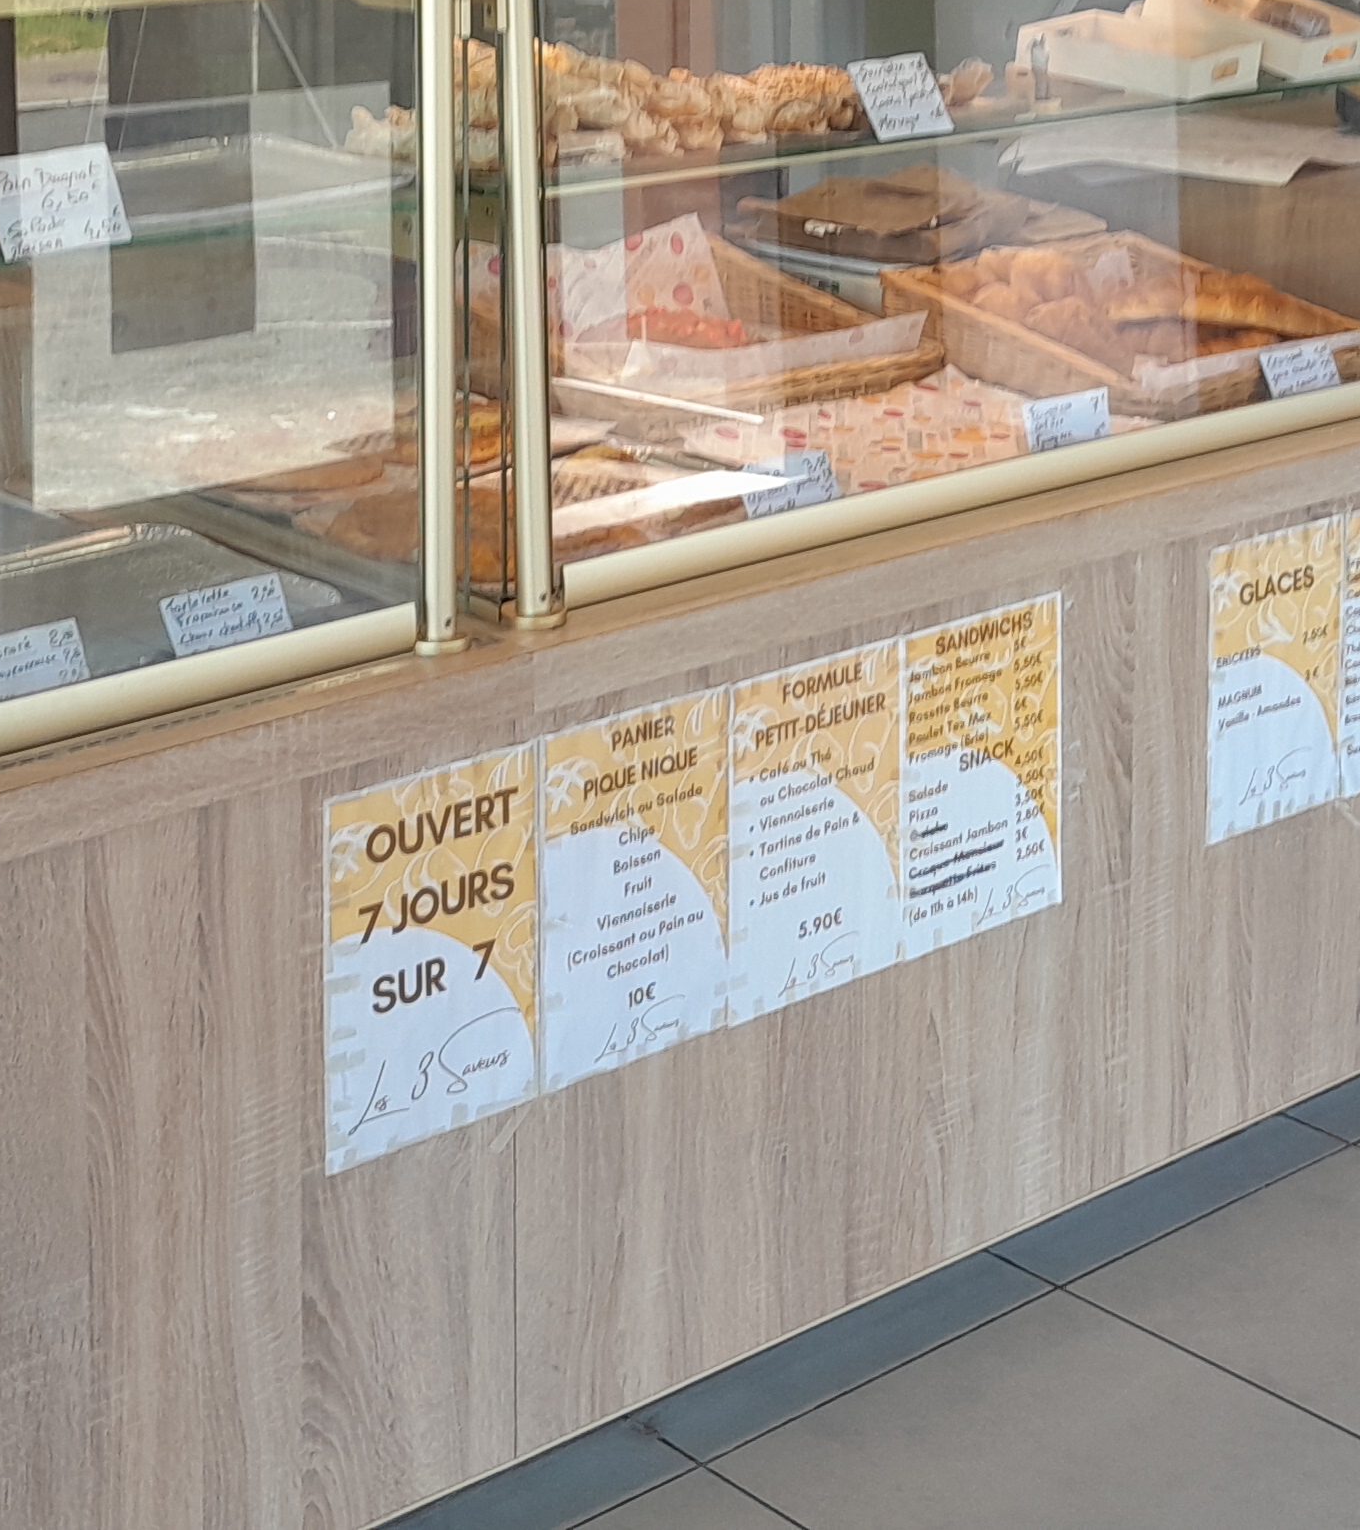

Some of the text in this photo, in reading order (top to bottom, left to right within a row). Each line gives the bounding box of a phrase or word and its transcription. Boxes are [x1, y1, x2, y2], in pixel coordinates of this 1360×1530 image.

[1240, 564, 1315, 606] GLACES
[935, 610, 1033, 655] SANDWICHS
[782, 661, 863, 704] FORMULE
[908, 684, 952, 705] Jambon
[955, 670, 1002, 691] Fromage
[909, 661, 953, 683] Jambon
[611, 715, 675, 753] PANIER
[755, 692, 886, 751] PETIT-DÉJEUNER
[908, 725, 944, 745] Poulet
[759, 747, 832, 782] Café ou Thé
[908, 741, 958, 765] Fromage
[959, 736, 1015, 773] SNACK
[583, 745, 698, 803] PIQUE NIQUE
[760, 756, 875, 807] ou Chocolat Chaud
[908, 780, 949, 803] Salade
[365, 787, 519, 864] OUVERT
[570, 782, 703, 835] Sandwich ou Salade
[759, 797, 835, 832] Viennoiserie
[909, 806, 938, 824] Pizza
[618, 824, 655, 846] Chips
[759, 810, 860, 857] Tartine de Pain &
[909, 831, 963, 861] Croissant
[965, 819, 1008, 844] Jambon
[613, 849, 661, 874] Boisson
[759, 852, 816, 881] Confiture
[357, 861, 515, 945] 7 JOURS
[624, 875, 652, 898] Fruit
[759, 871, 827, 906] Jus de fruit
[596, 892, 677, 931] Viennoiserie
[798, 906, 844, 940] 5.90€
[908, 907, 928, 927] (de
[946, 897, 954, 908] à
[957, 885, 978, 904] 14h)
[567, 910, 704, 973] (Croissant ou Pain au
[372, 938, 496, 1014] SUR 7
[607, 943, 669, 980] Chocolat)
[628, 981, 657, 1010] 10€
[626, 1016, 640, 1044] 3
[348, 1005, 522, 1136] Les 3 Saveurs
